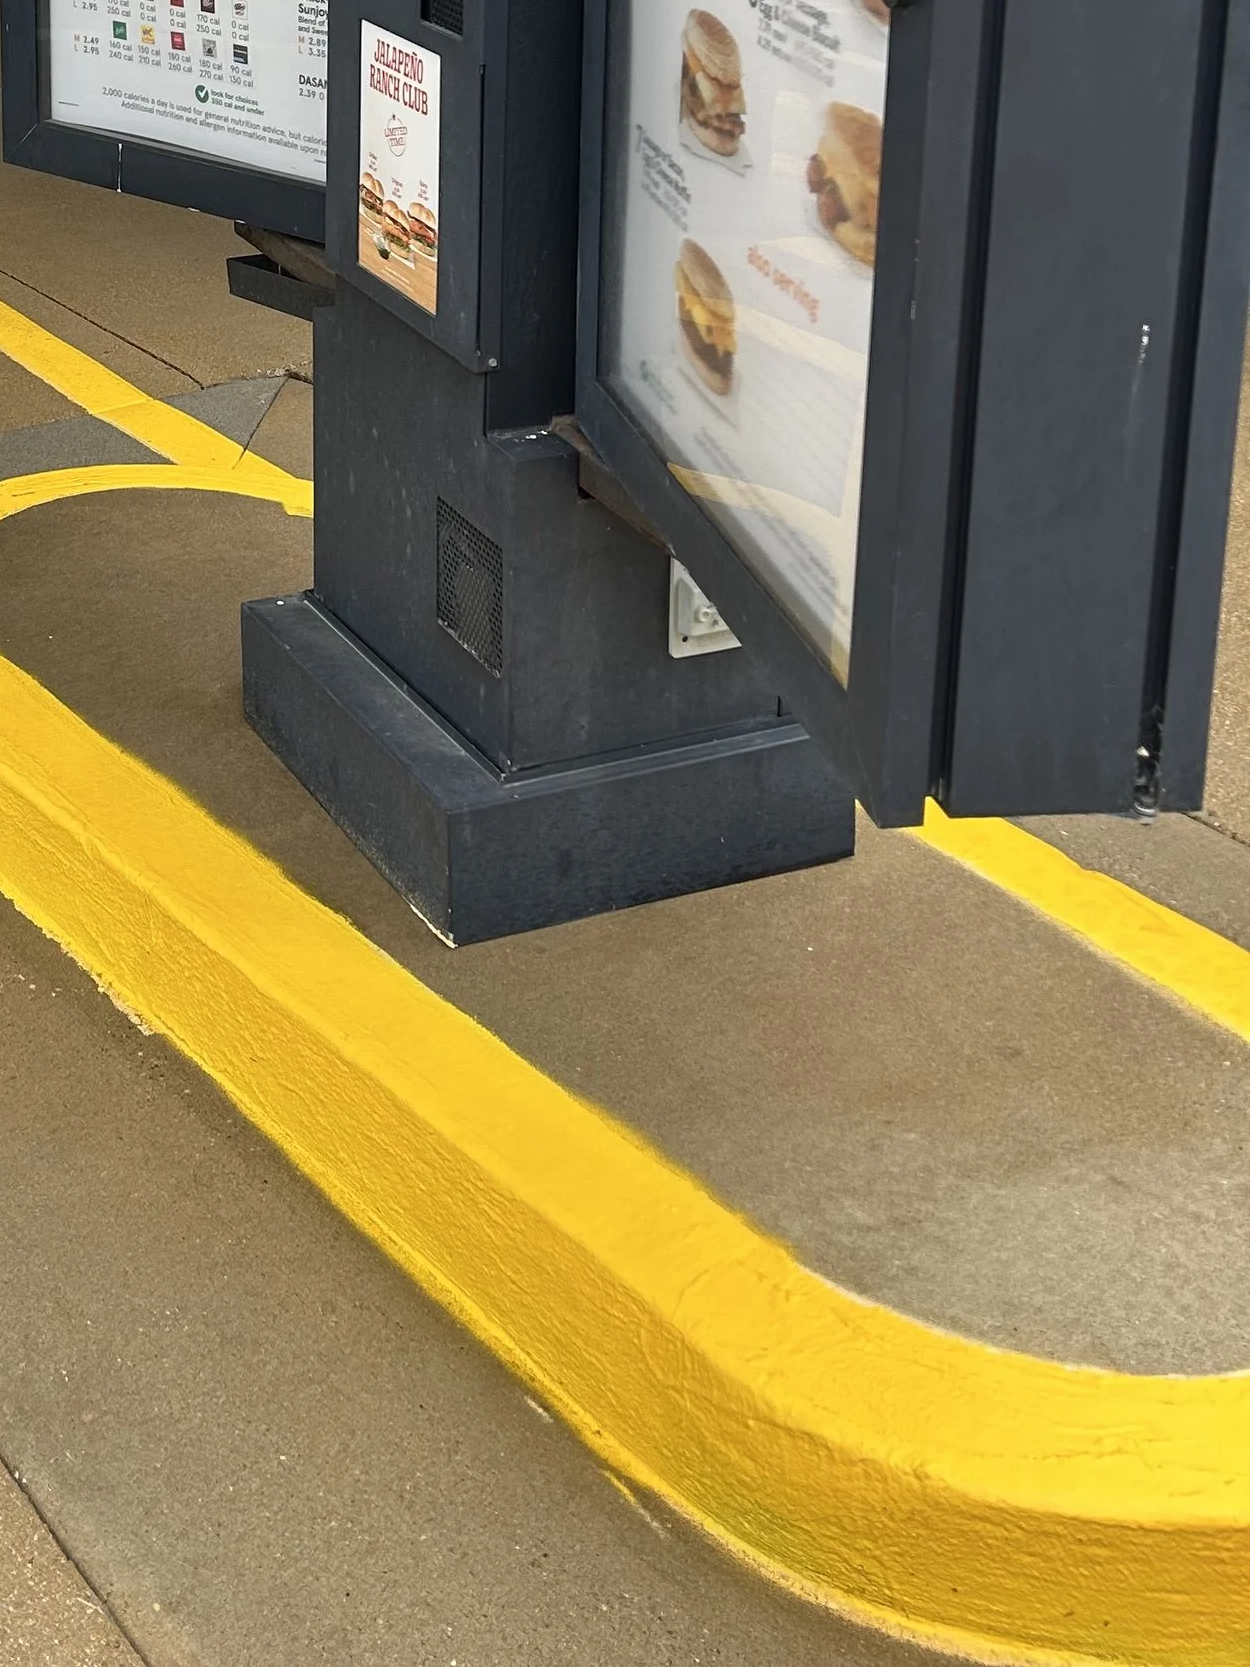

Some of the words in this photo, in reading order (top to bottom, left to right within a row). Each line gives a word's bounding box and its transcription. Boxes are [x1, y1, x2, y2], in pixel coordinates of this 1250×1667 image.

[73, 0, 78, 8] L
[82, 2, 98, 11] 2.95
[120, 0, 130, 7] cal
[121, 9, 131, 17] cal
[210, 18, 220, 26] cal
[298, 16, 316, 27] Blend
[318, 19, 326, 27] of
[212, 28, 222, 36] cal
[298, 26, 310, 34] and
[74, 34, 80, 42] M
[83, 36, 99, 45] 2.49
[298, 35, 305, 44] M
[308, 37, 327, 47] 2.89
[74, 44, 79, 52] L
[83, 46, 100, 55] 2.95
[122, 44, 132, 52] cal
[151, 48, 161, 56] cal
[298, 46, 303, 54] L
[308, 47, 327, 58] 3.35
[123, 54, 133, 62] cal
[151, 59, 161, 67] cal
[374, 38, 424, 85] JALAPEÑO
[213, 73, 224, 81] cal
[241, 69, 252, 77] cal
[243, 79, 253, 88] cal
[299, 88, 316, 99] 2.39
[319, 92, 325, 100] 0
[370, 64, 400, 103] RANCH
[402, 82, 428, 116] CLUB
[211, 98, 222, 106] 350
[224, 101, 232, 109] cal
[234, 104, 245, 112] and
[246, 107, 264, 116] under
[102, 87, 122, 98] 2,000
[124, 92, 150, 104] calories
[156, 99, 168, 108] day
[176, 104, 191, 113] used
[193, 107, 202, 116] for
[205, 111, 229, 122] general
[231, 117, 260, 131] nutrition
[289, 130, 301, 140] but
[121, 100, 154, 114] Additional
[156, 109, 184, 121] nutrition
[186, 116, 197, 125] and
[200, 119, 226, 132] allergen
[227, 128, 266, 142] information
[268, 137, 298, 150] available
[300, 144, 318, 154] upon
